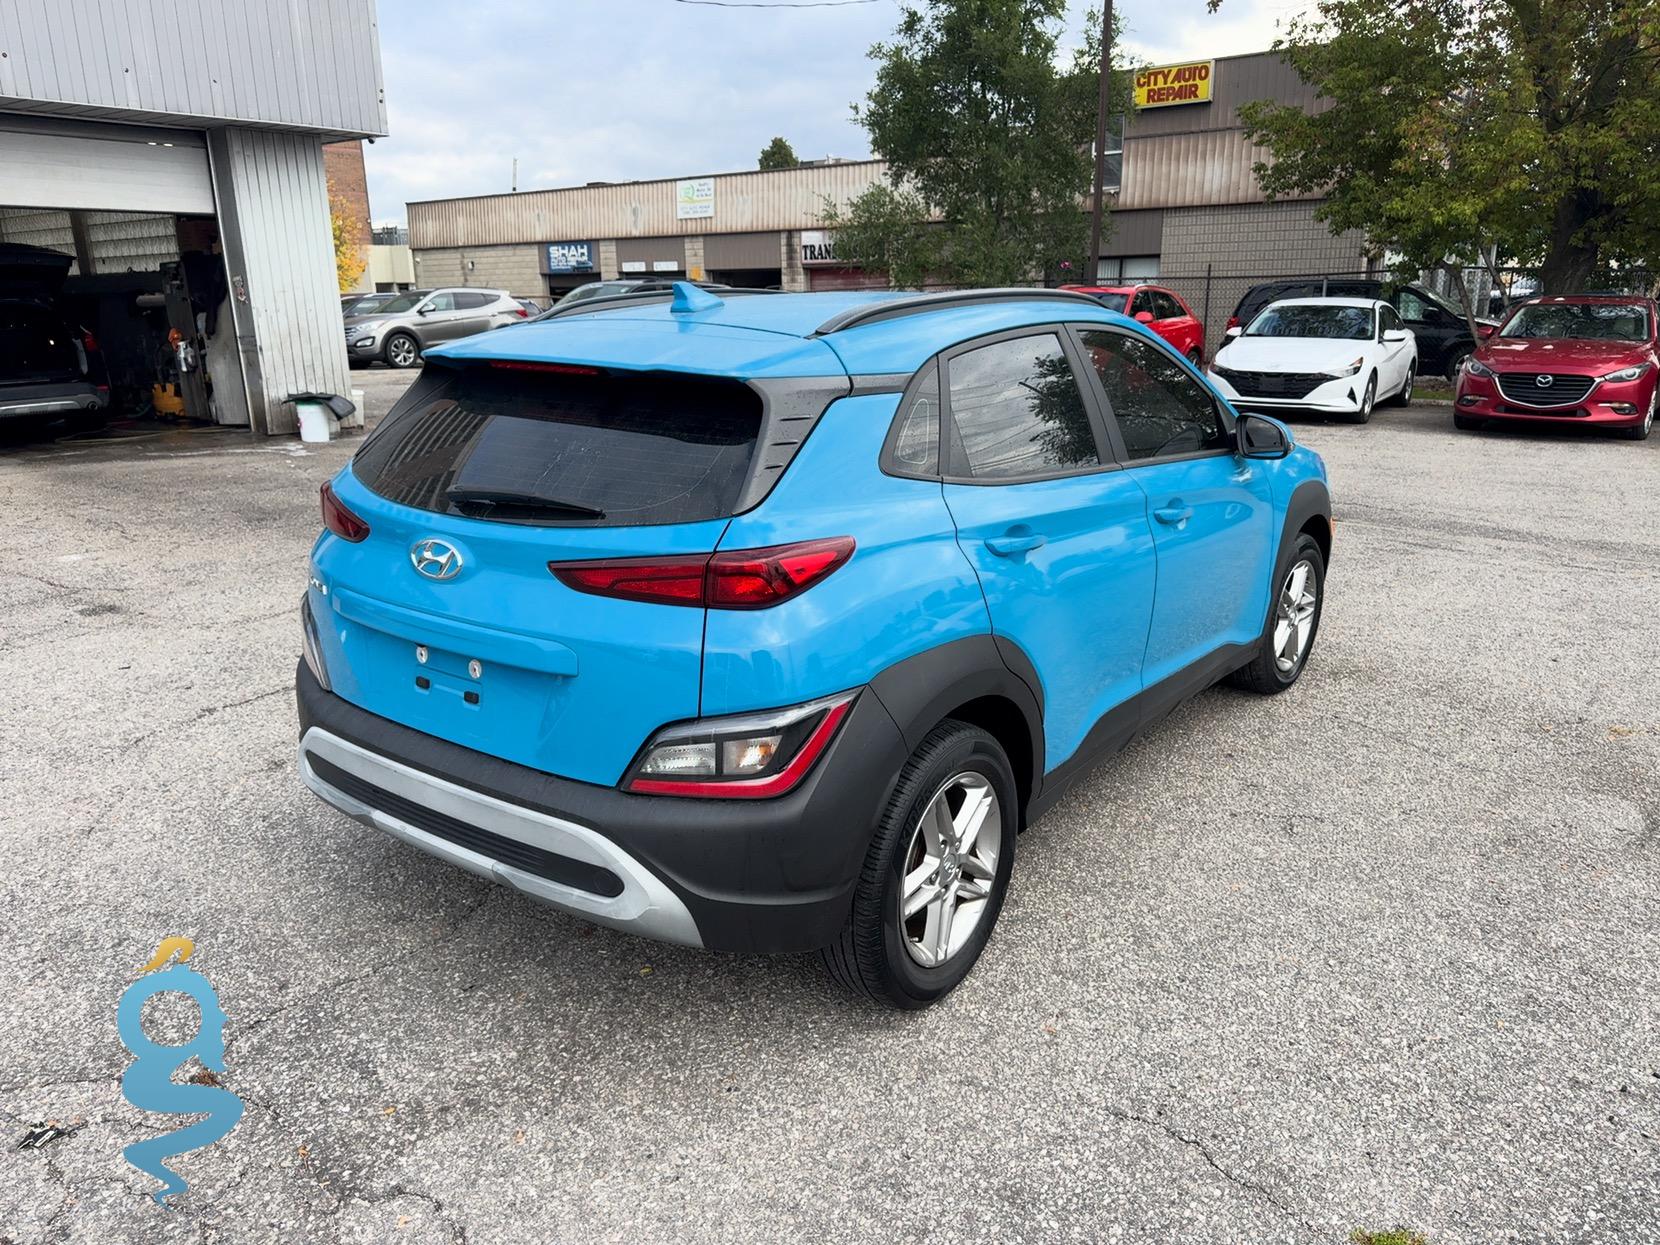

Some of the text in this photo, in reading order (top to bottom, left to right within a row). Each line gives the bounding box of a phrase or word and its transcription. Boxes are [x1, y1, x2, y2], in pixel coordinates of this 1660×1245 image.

[1136, 65, 1209, 88] CITY AUTO
[1146, 83, 1199, 104] REPAIR
[549, 244, 588, 258] SHAH
